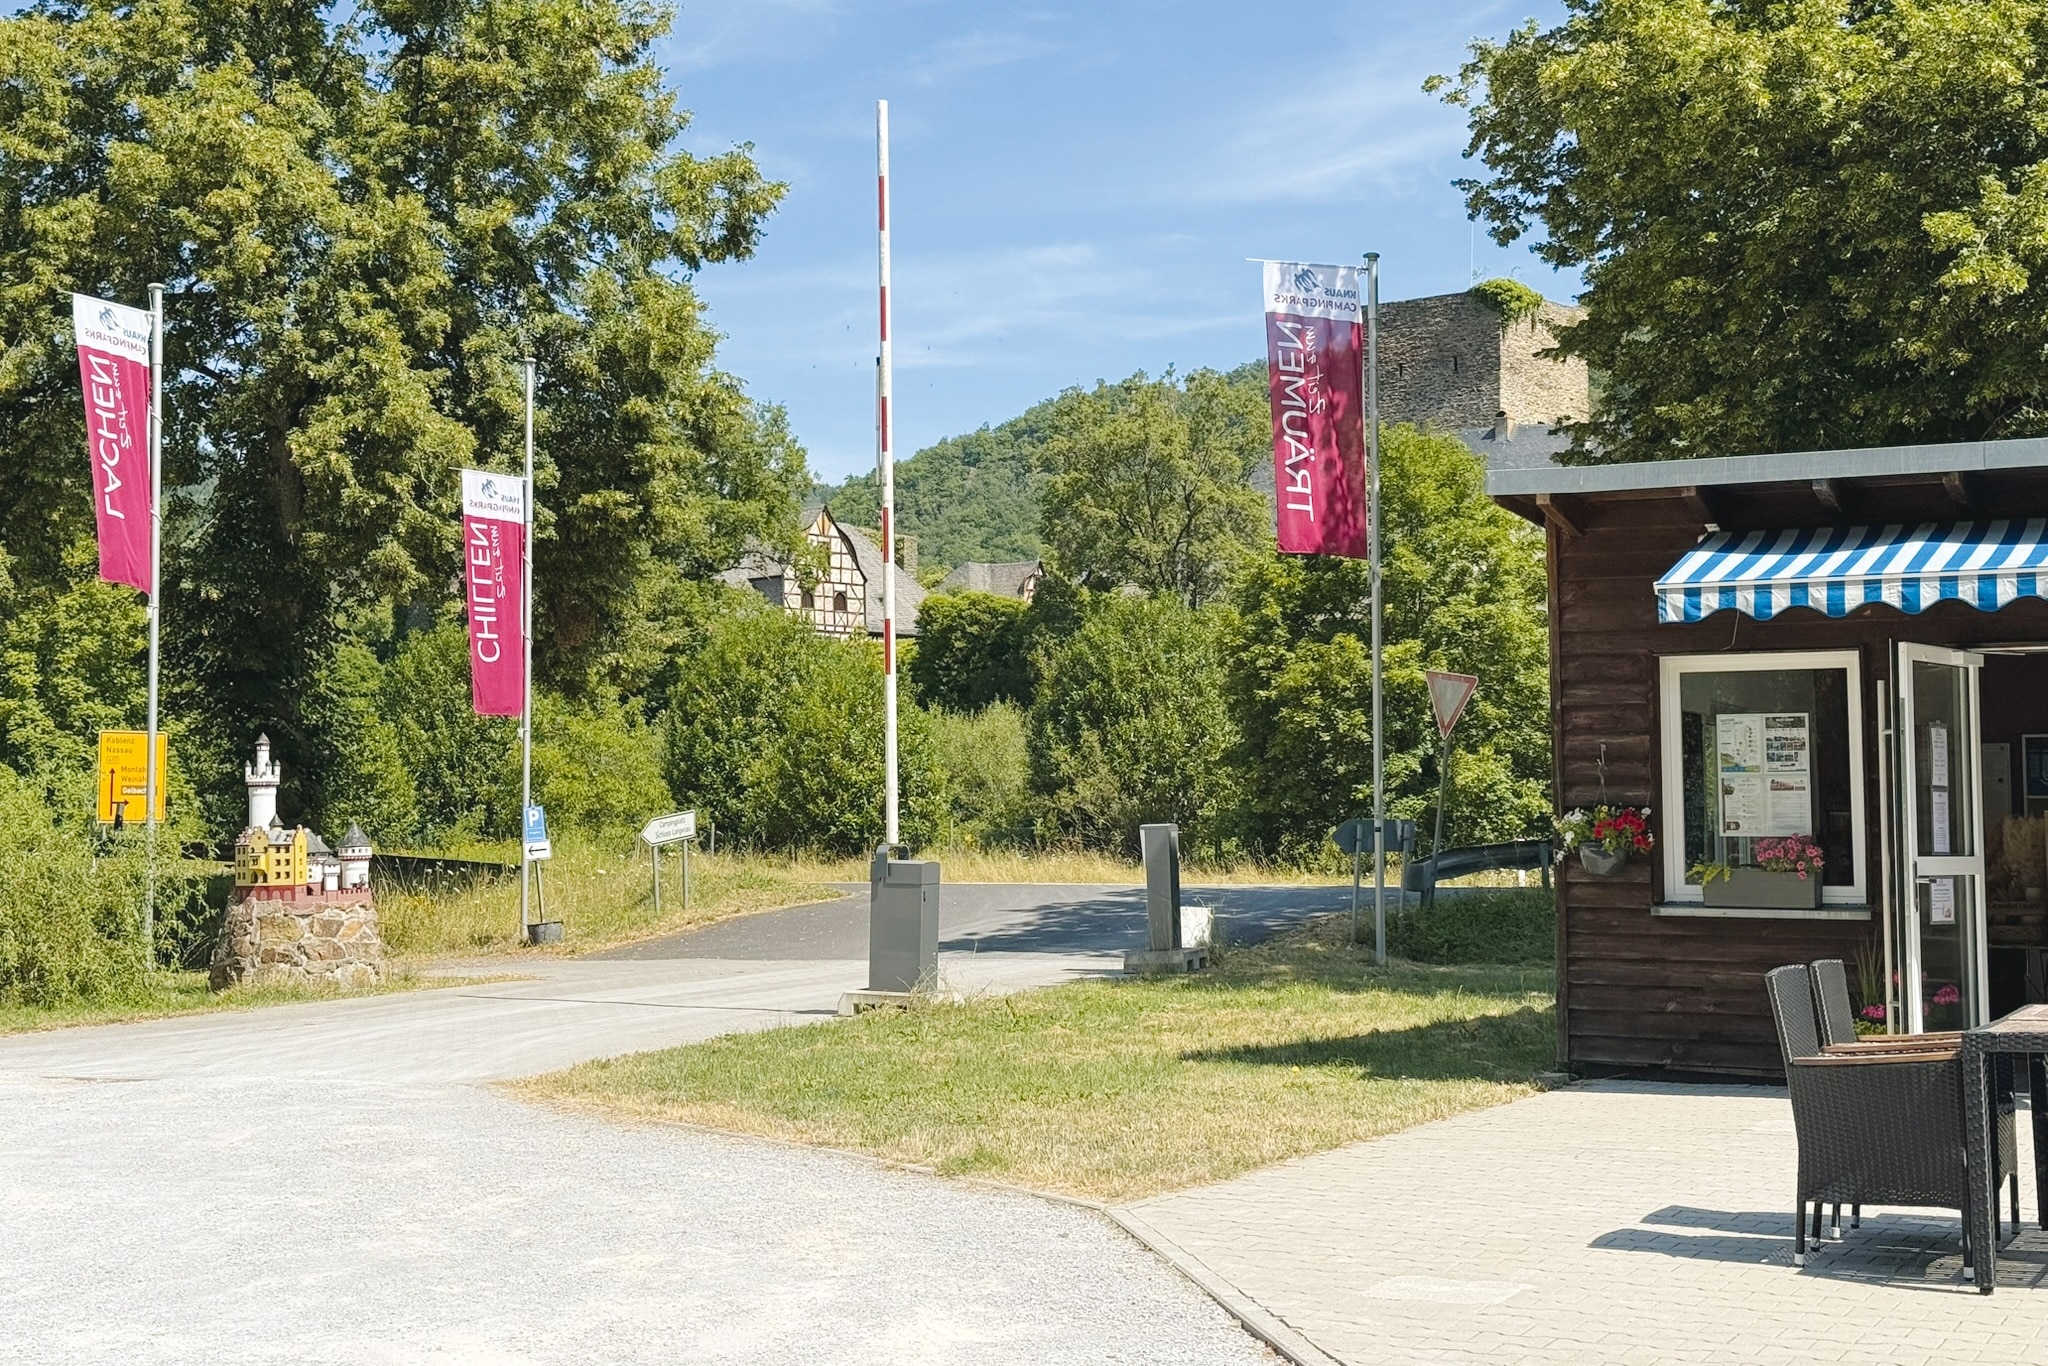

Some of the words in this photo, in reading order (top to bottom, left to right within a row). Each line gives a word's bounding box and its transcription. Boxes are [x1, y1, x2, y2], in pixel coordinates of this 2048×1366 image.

[106, 736, 135, 744] Koblenz
[106, 746, 133, 754] Nassau
[528, 810, 539, 827] P
